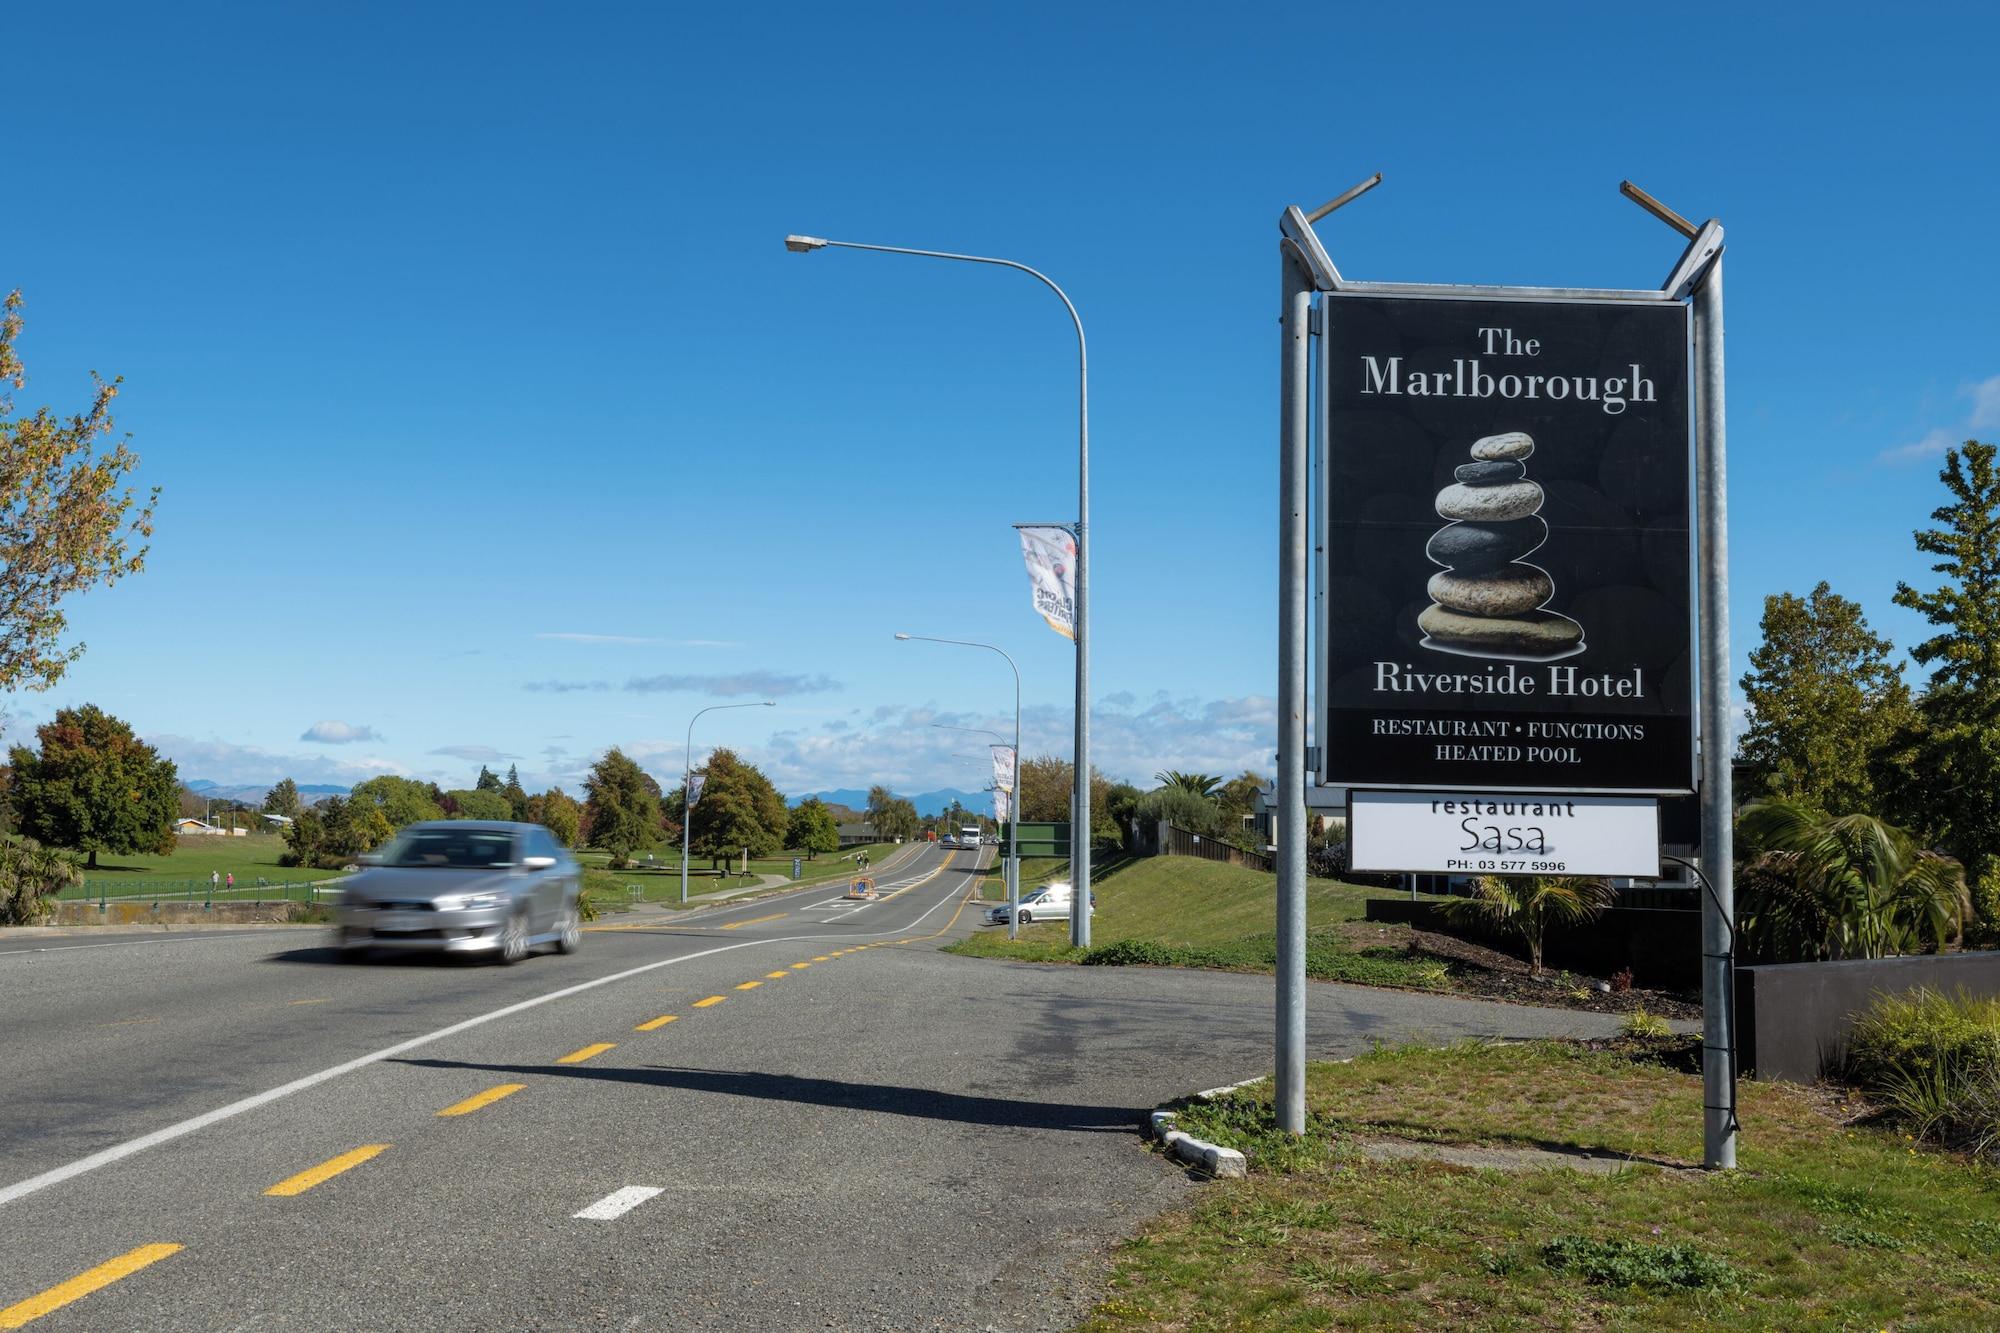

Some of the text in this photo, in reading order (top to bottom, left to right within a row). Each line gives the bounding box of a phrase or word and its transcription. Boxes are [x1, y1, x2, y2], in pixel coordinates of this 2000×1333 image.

[1478, 327, 1541, 356] The
[1361, 355, 1657, 415] Marlborough
[1373, 661, 1645, 698] Riverside Hotel
[1372, 719, 1645, 740] RESTAURANT FUNCTIONS
[1435, 745, 1581, 763] HEATED POOL
[1431, 799, 1576, 817] restaurant
[1460, 817, 1546, 855] Sasa
[1447, 859, 1566, 872] PH: 03 577 5996
